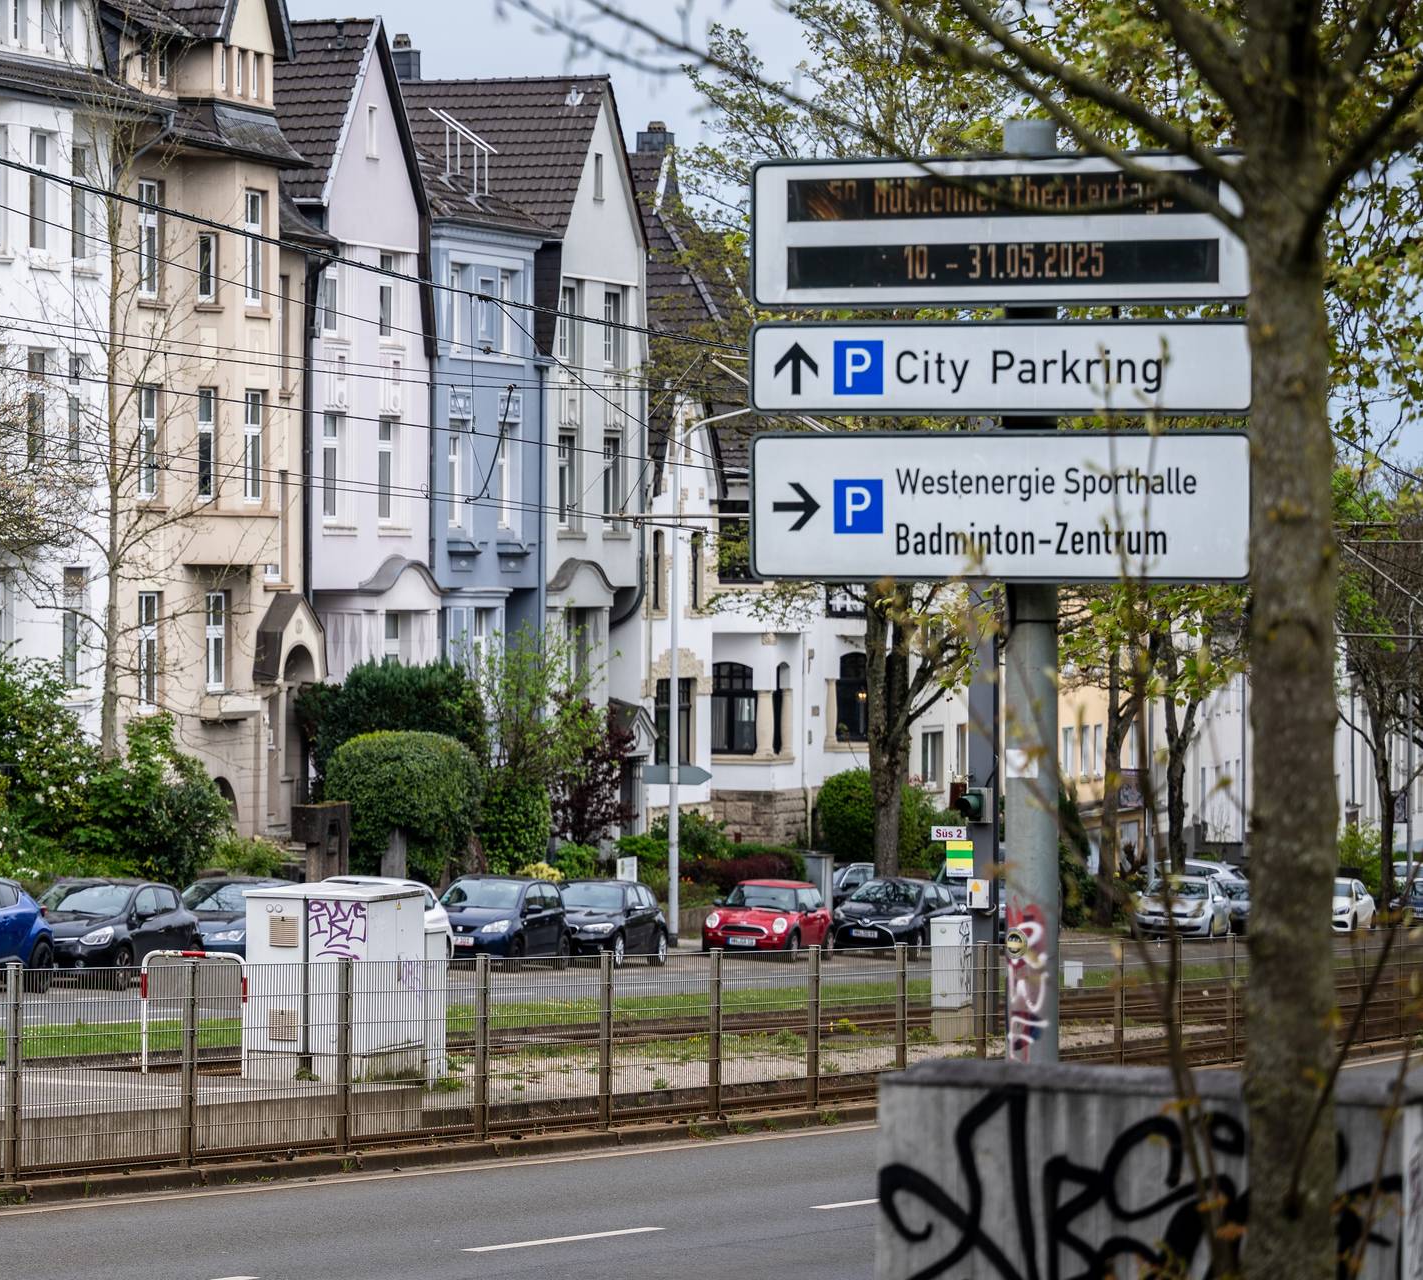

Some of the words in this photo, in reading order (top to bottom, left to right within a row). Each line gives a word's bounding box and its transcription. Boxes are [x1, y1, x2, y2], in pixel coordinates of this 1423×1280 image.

[903, 245, 936, 280] 10.
[968, 242, 1105, 279] 31.05.2025
[845, 347, 871, 388] P
[895, 350, 970, 394] City
[991, 349, 1164, 394] Parkring
[895, 467, 1056, 502] Westenergie
[1063, 466, 1198, 502] Sporthalle
[845, 486, 872, 527] P
[895, 522, 1168, 556] Badminton-Zentrum
[936, 829, 953, 838] Süs
[957, 829, 962, 838] 2
